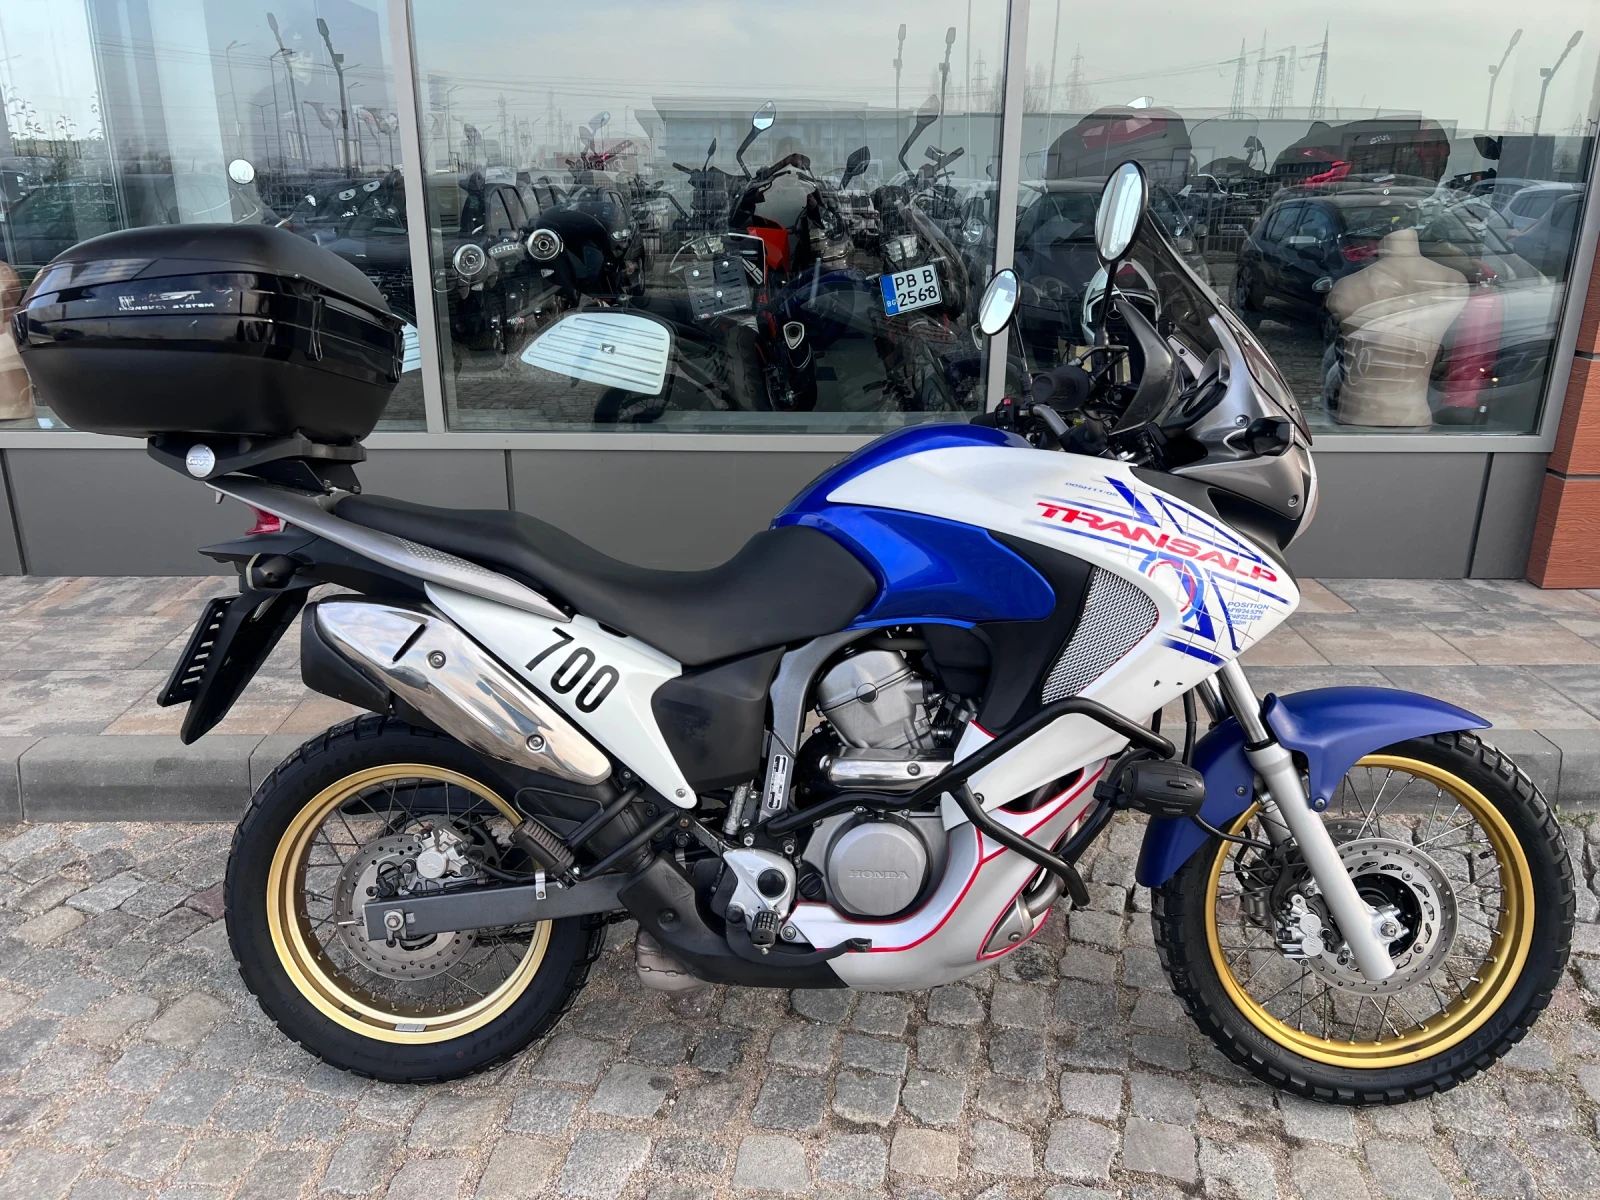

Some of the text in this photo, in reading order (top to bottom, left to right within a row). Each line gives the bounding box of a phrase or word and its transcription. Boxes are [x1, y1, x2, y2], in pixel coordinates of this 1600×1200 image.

[894, 269, 935, 291] PB B
[886, 299, 897, 308] BG
[897, 285, 938, 308] 2568
[1036, 501, 1278, 583] TRANSALP
[1227, 601, 1270, 610] POSITION
[524, 626, 620, 714] 700
[848, 869, 911, 879] HONDA
[1430, 1009, 1512, 1074] PIRELLI
